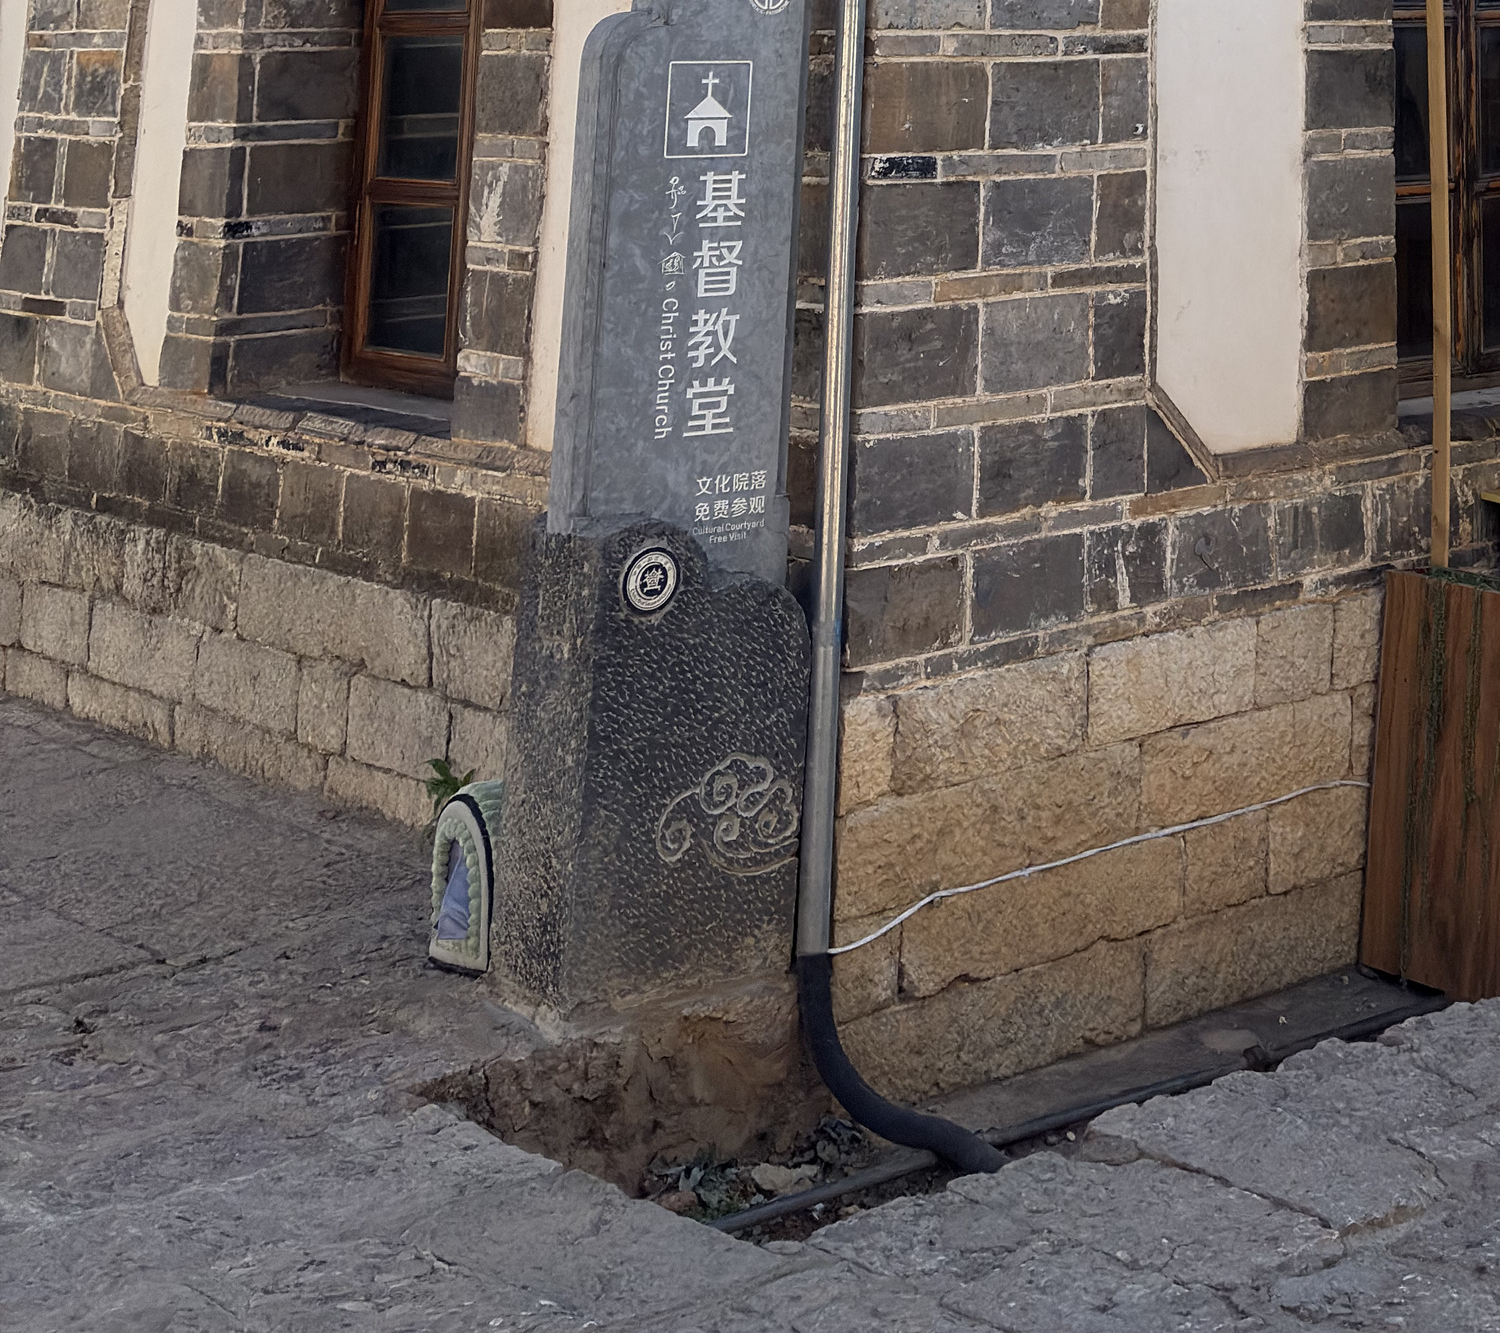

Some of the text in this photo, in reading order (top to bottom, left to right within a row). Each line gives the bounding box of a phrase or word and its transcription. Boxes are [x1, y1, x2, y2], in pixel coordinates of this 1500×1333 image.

[682, 170, 747, 437] 基督教堂
[659, 297, 679, 361] Christ
[654, 363, 676, 440] Church
[694, 469, 768, 497] 文化院落
[694, 495, 766, 522] 免费参观
[692, 517, 765, 535] Cultural Courtyard
[709, 531, 747, 544] Free Visit
